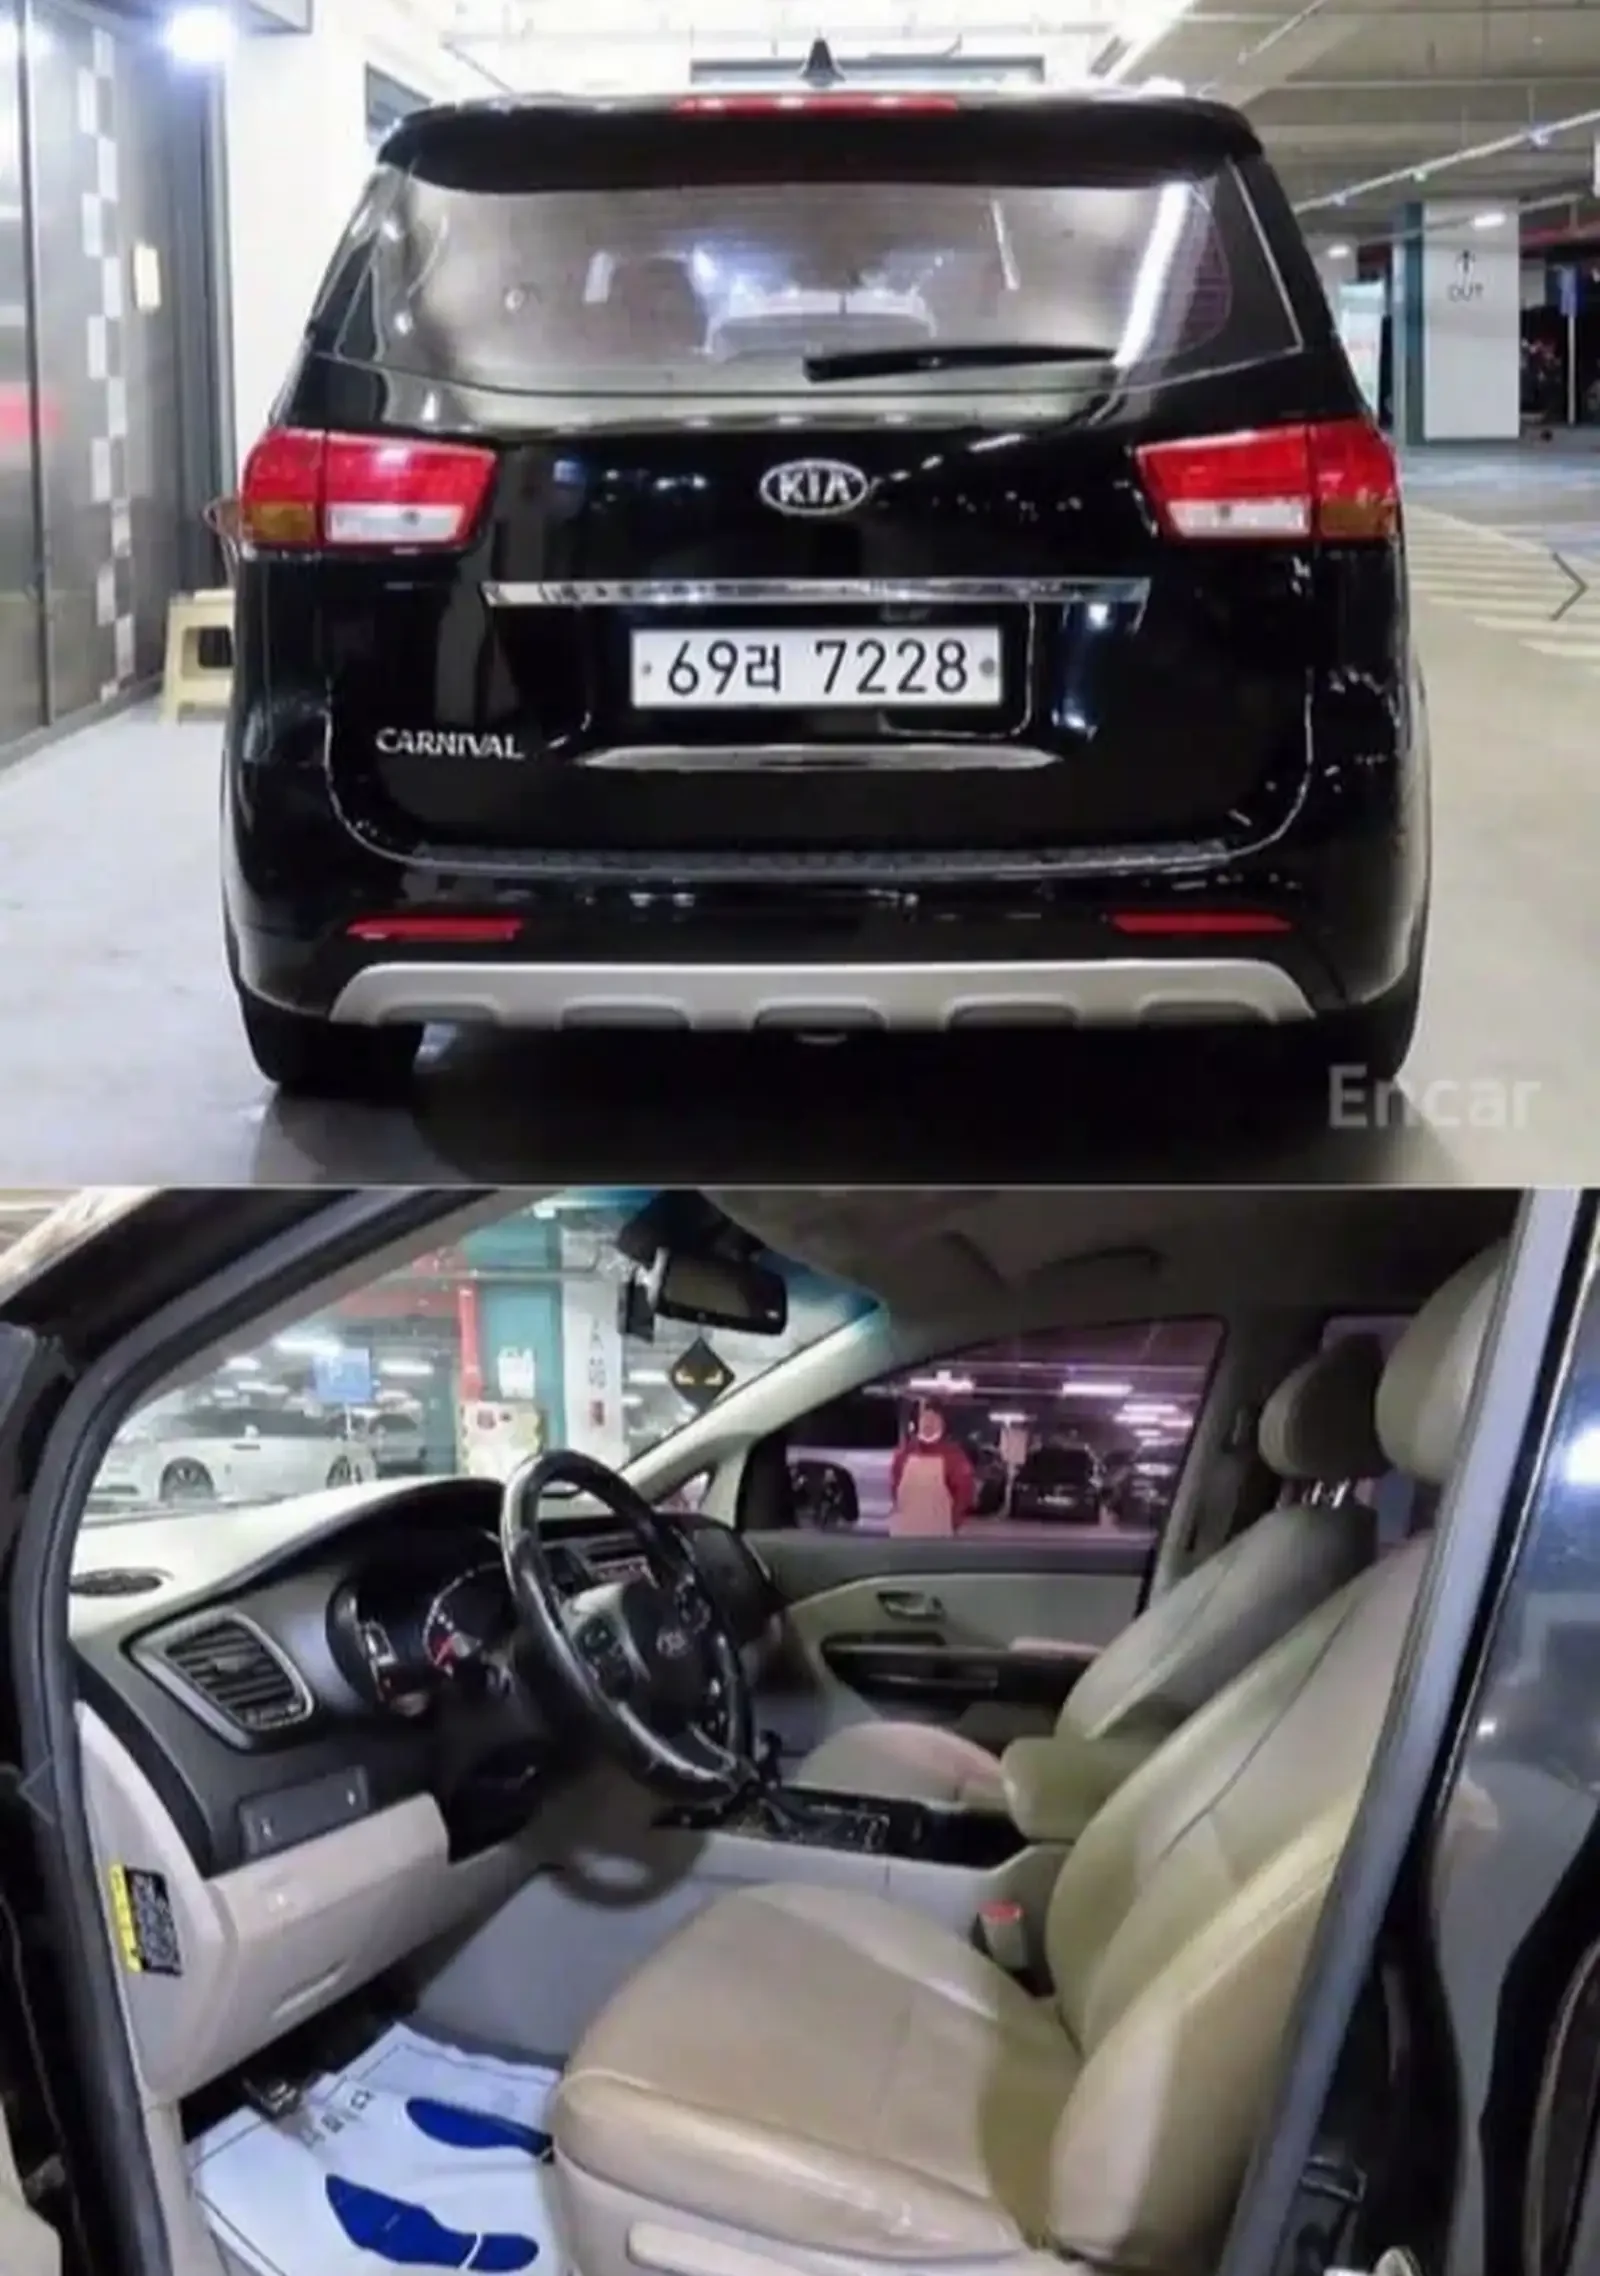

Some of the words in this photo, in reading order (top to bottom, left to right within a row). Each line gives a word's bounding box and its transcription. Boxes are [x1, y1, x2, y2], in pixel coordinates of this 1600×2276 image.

[777, 464, 853, 506] KIA
[815, 639, 967, 694] 7228
[376, 726, 525, 760] CARNIVAL
